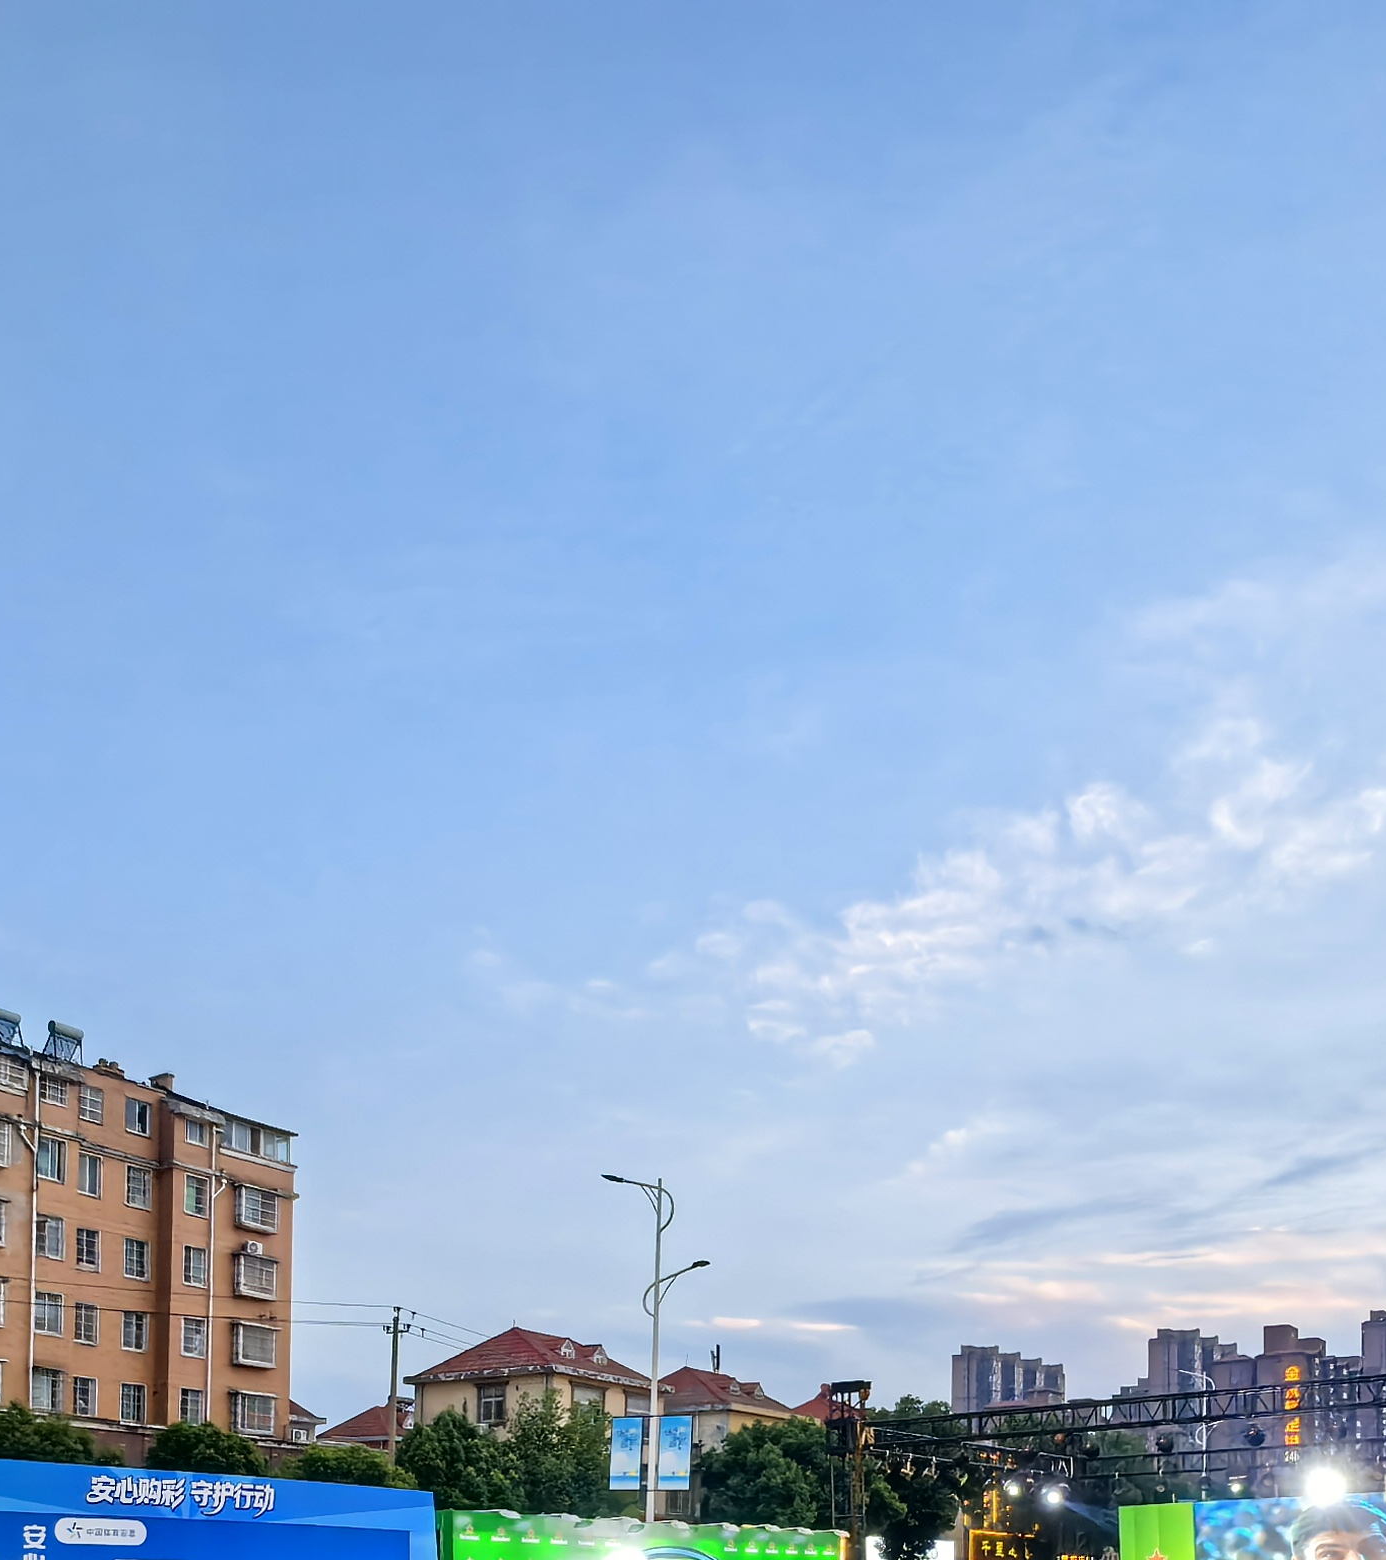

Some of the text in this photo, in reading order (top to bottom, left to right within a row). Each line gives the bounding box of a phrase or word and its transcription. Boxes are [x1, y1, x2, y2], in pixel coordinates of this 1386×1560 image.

[86, 1475, 275, 1518] 安心购彩 守护行动
